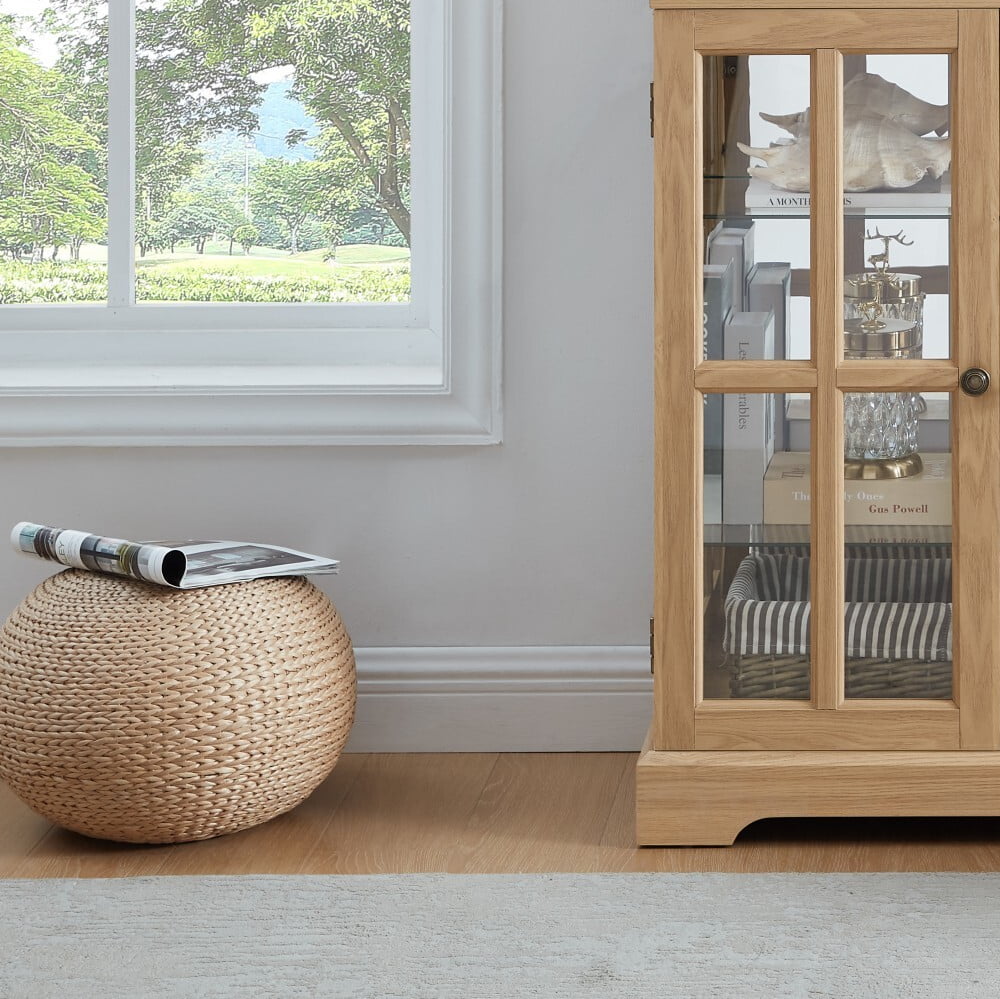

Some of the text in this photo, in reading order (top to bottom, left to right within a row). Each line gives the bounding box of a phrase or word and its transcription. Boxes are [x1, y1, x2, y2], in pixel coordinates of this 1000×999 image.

[769, 198, 811, 206] A MONTH
[868, 504, 929, 514] Gus Powell
